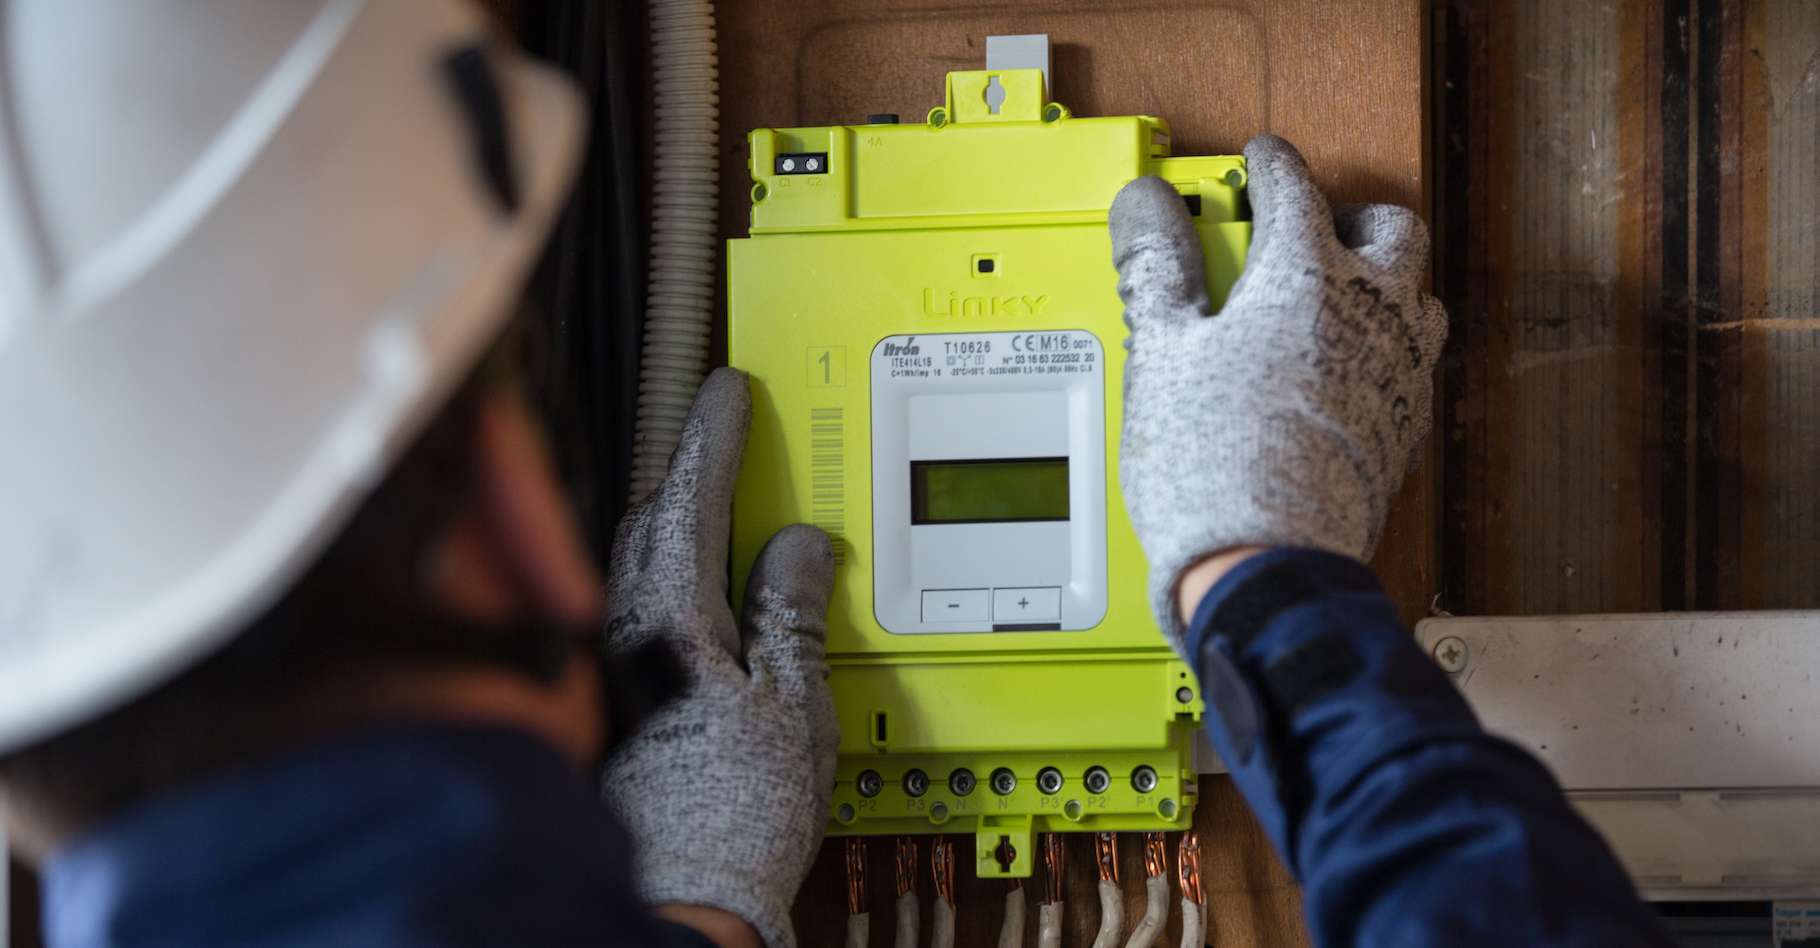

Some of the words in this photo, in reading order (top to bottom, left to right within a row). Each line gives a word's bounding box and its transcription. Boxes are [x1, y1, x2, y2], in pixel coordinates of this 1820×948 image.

[807, 177, 822, 187] C2
[944, 340, 991, 354] T10626
[1040, 335, 1068, 350] M16
[818, 351, 830, 384] 1
[907, 798, 925, 810] P3
